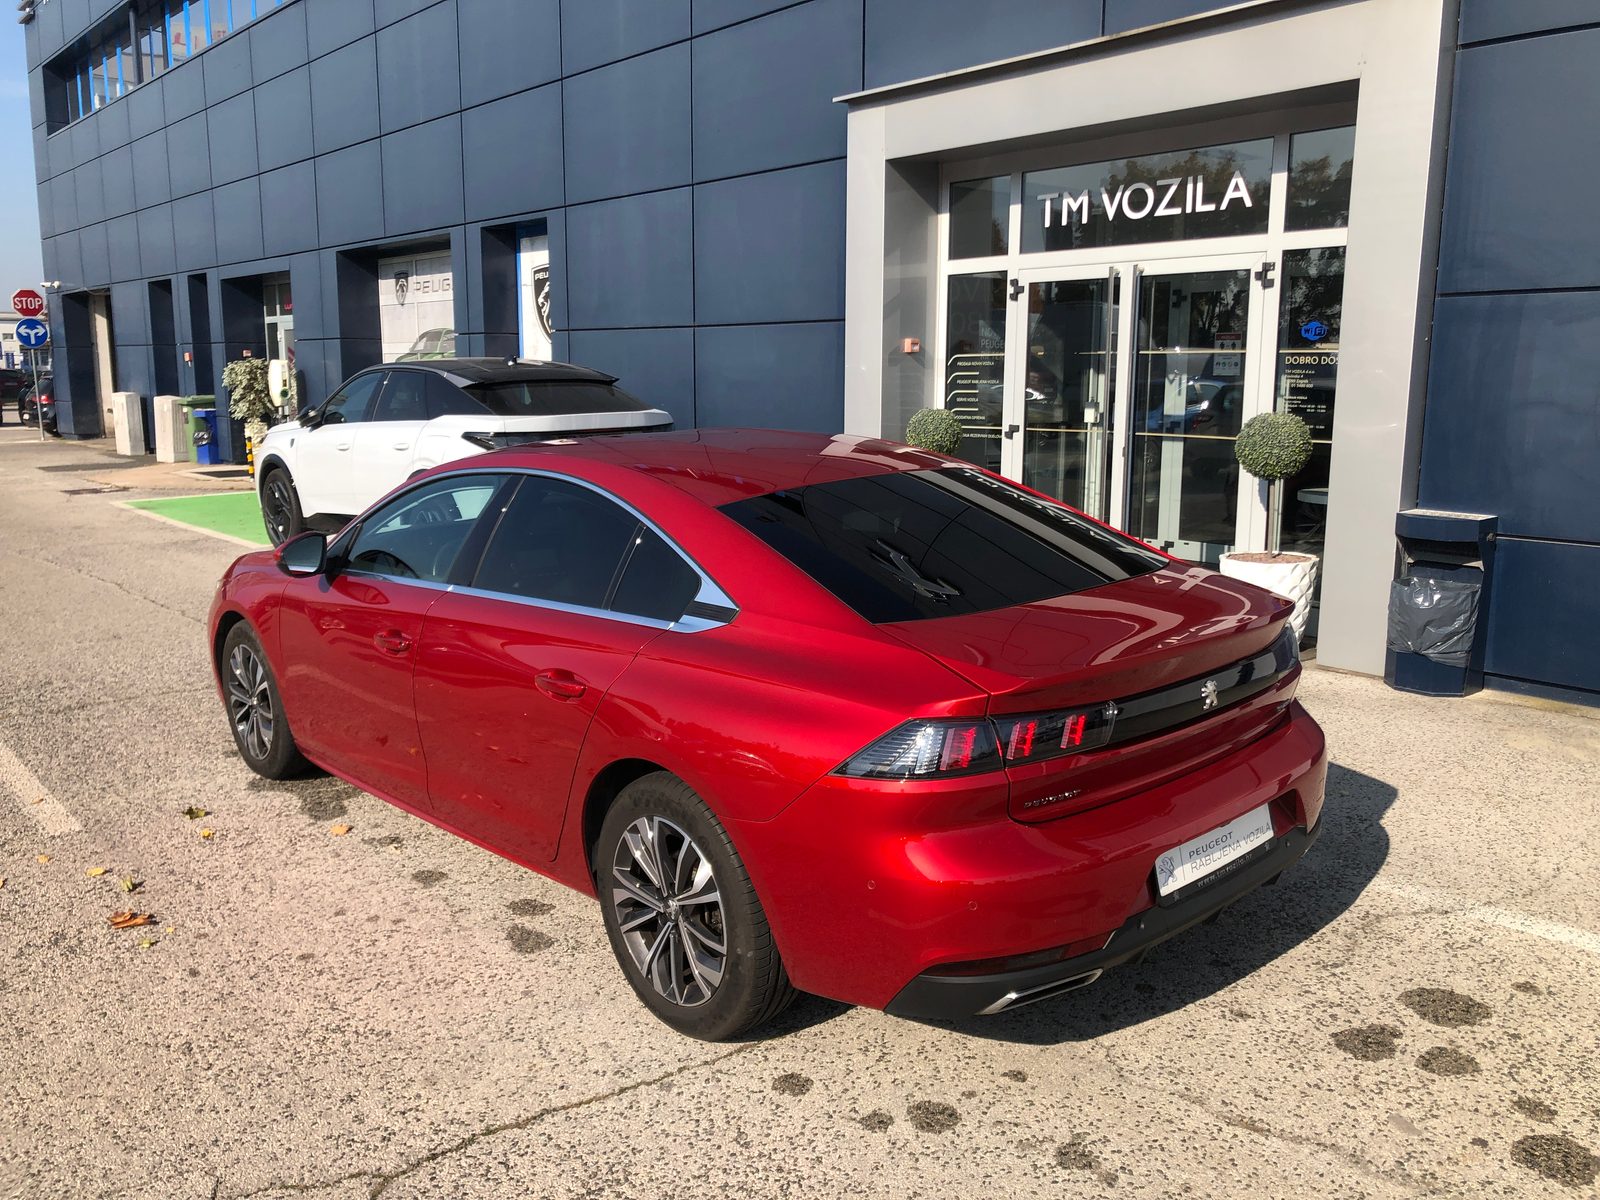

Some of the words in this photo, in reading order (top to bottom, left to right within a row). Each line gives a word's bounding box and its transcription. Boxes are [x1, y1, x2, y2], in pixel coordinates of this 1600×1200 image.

[1036, 188, 1090, 228] TM
[1100, 170, 1253, 221] VOZILA
[413, 277, 452, 294] PEUG
[14, 297, 42, 310] STOP
[1285, 355, 1319, 365] DOBRO
[1024, 789, 1082, 808] PEUGEOT
[1188, 830, 1234, 859] PEUGEOT
[1190, 842, 1243, 873] RABLJENA
[1243, 821, 1272, 846] VOZILA
